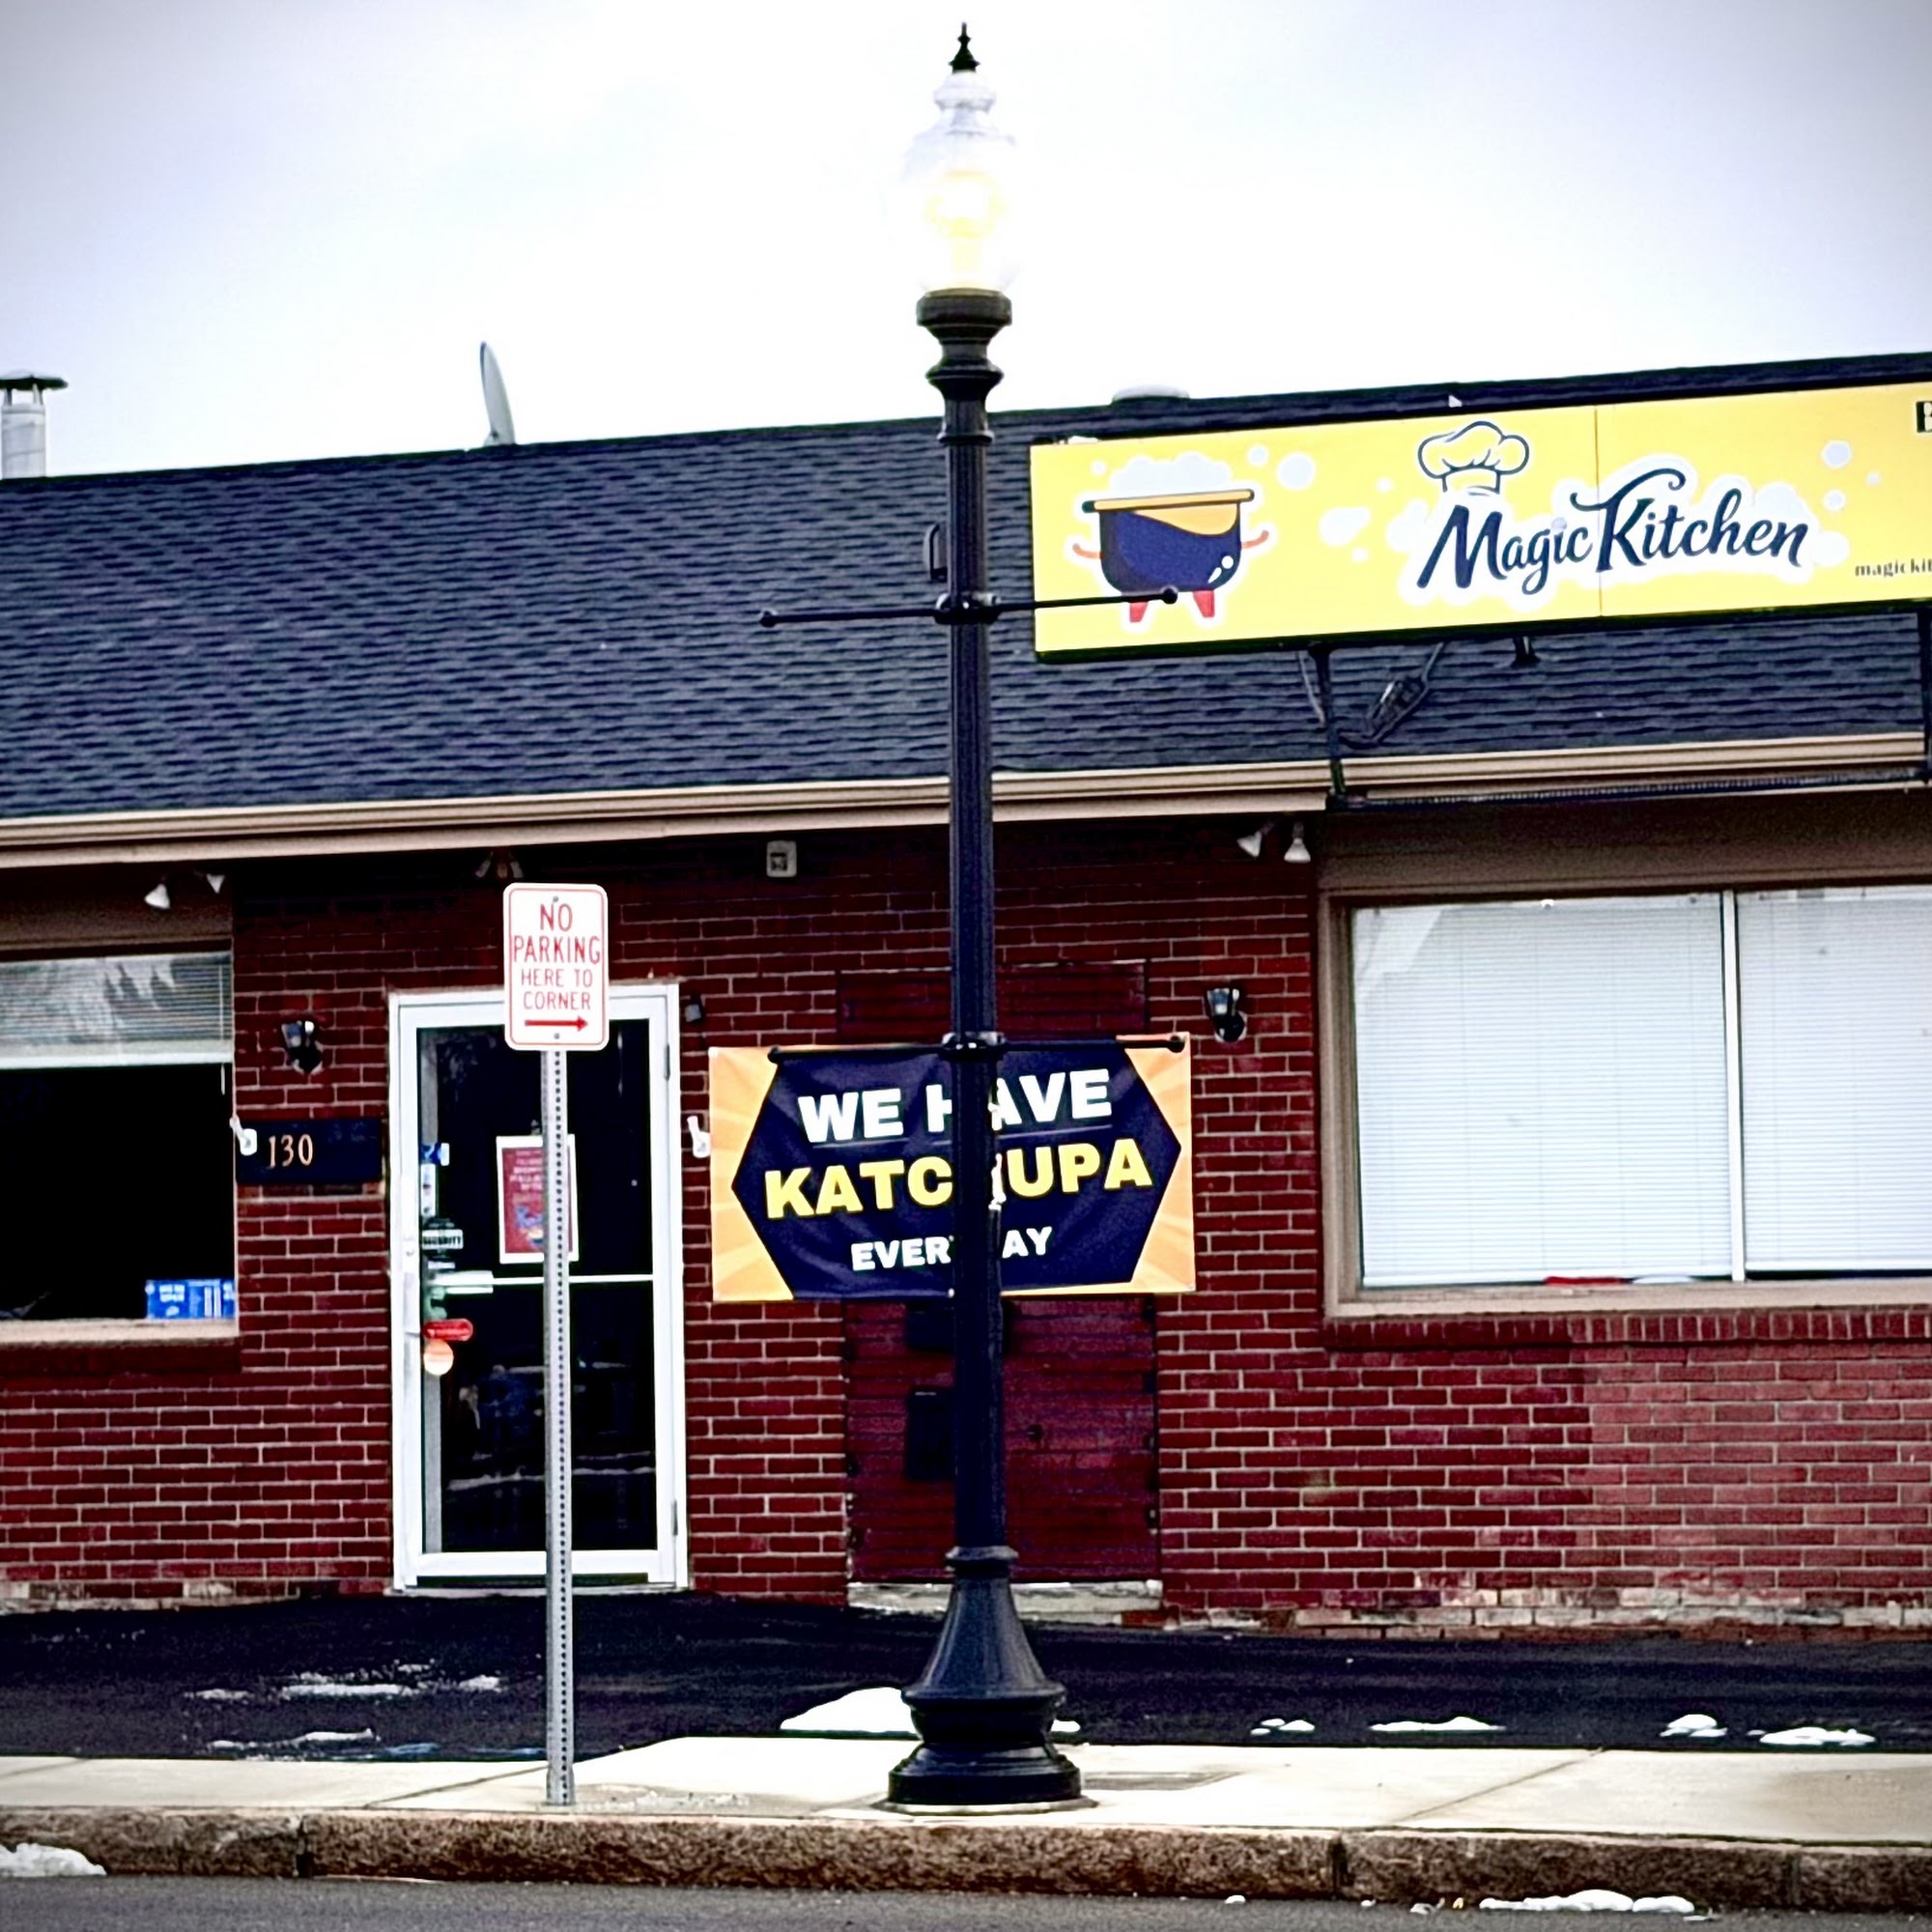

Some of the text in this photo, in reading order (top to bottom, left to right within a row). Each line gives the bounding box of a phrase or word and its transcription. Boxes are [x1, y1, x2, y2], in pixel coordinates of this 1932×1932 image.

[1416, 468, 1808, 595] Magic Kitchen
[539, 902, 573, 932] NO
[513, 935, 601, 965] PARKING
[521, 968, 594, 987] HERE TO
[523, 991, 591, 1010] CORNER
[798, 1088, 903, 1144] WE
[268, 1133, 314, 1168] 130
[764, 1138, 1153, 1220] KATCUPA
[851, 1226, 1052, 1271] EVERAY
